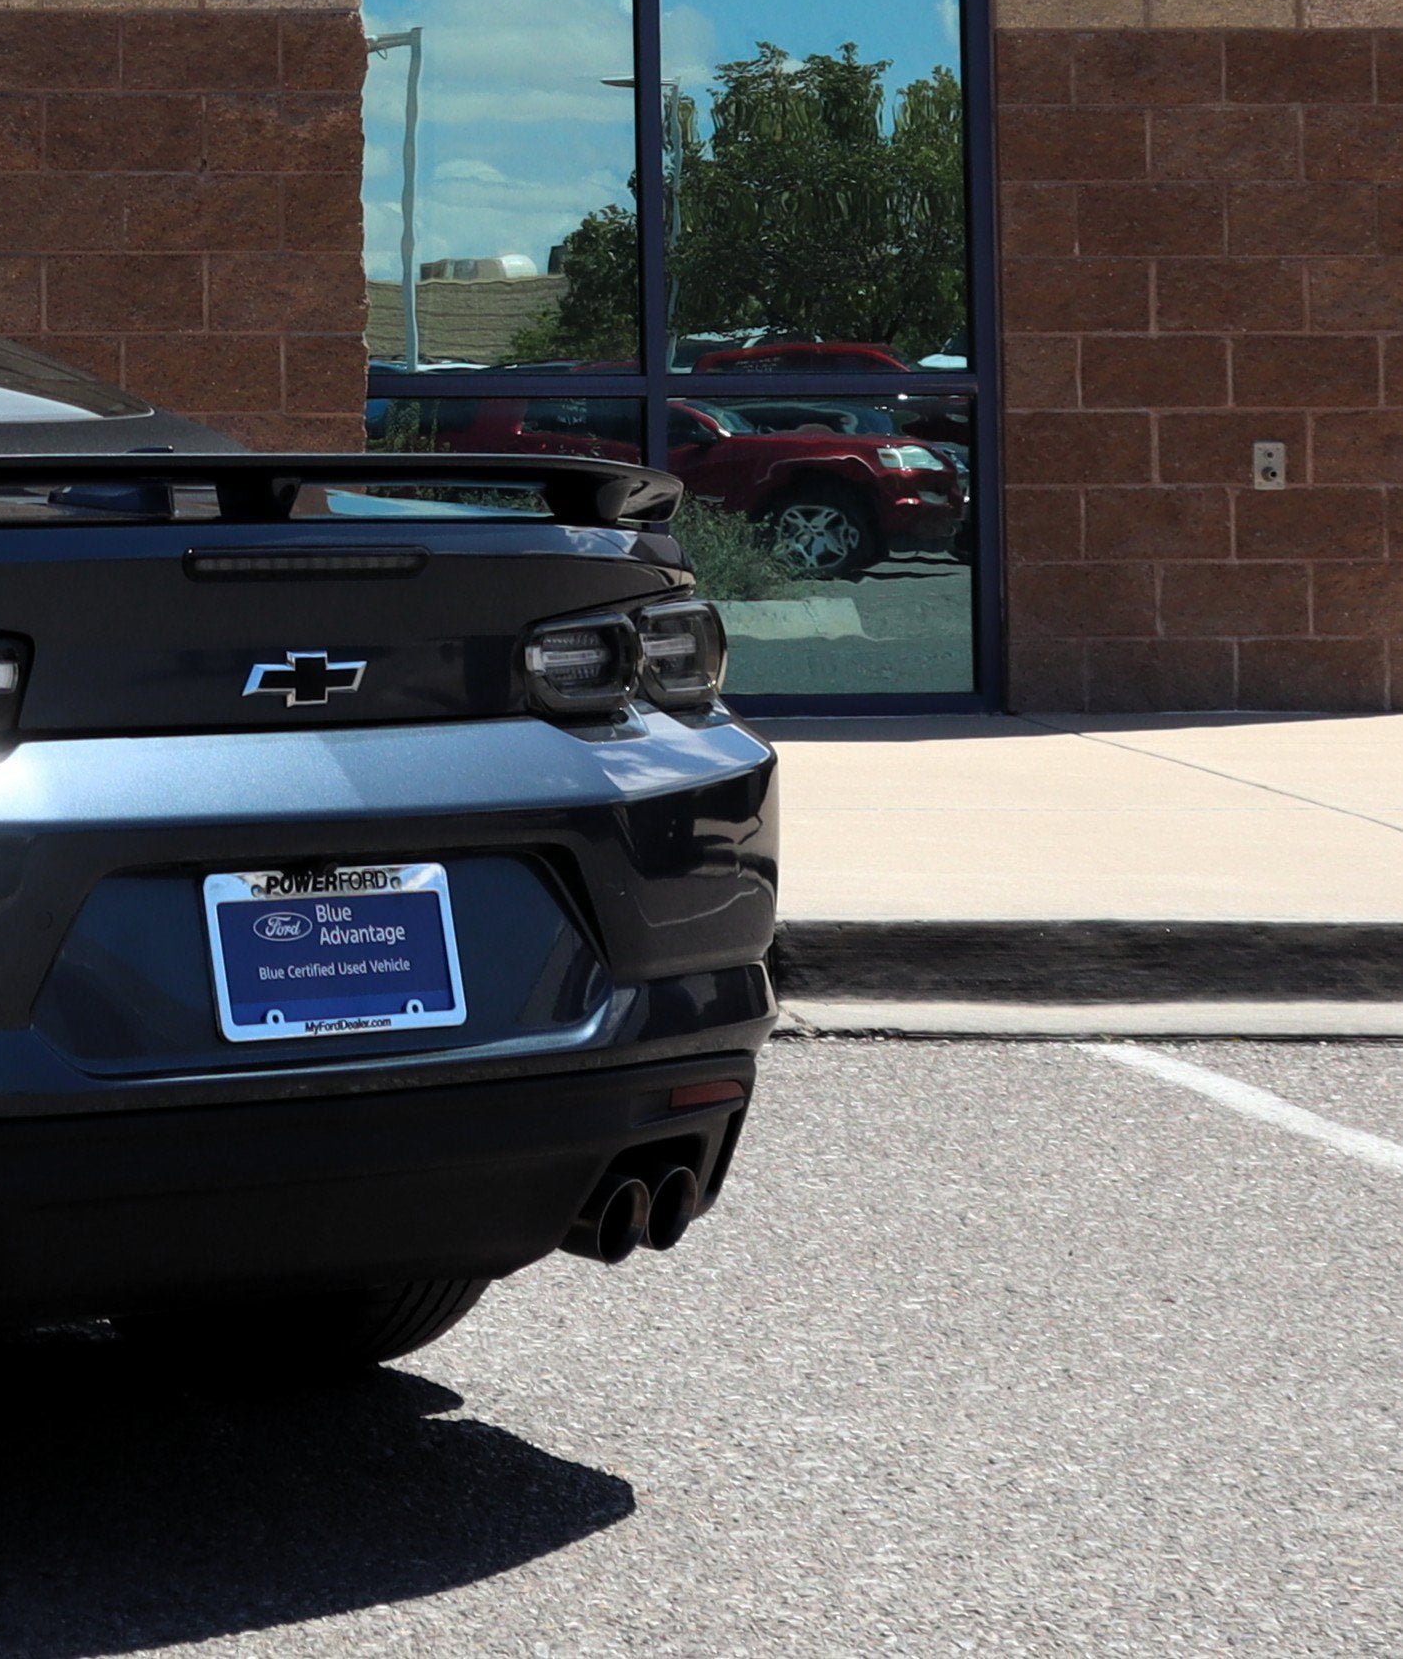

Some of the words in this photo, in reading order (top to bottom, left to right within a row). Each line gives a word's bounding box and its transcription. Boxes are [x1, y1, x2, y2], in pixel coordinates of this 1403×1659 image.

[315, 903, 352, 922] Blue
[265, 916, 302, 937] Ford
[319, 925, 406, 946] Advantage
[258, 966, 285, 981] Blue
[288, 962, 336, 979] Certified
[338, 960, 367, 975] Used
[369, 957, 411, 973] Vehicle
[305, 1018, 392, 1035] MyFordDealer.com
